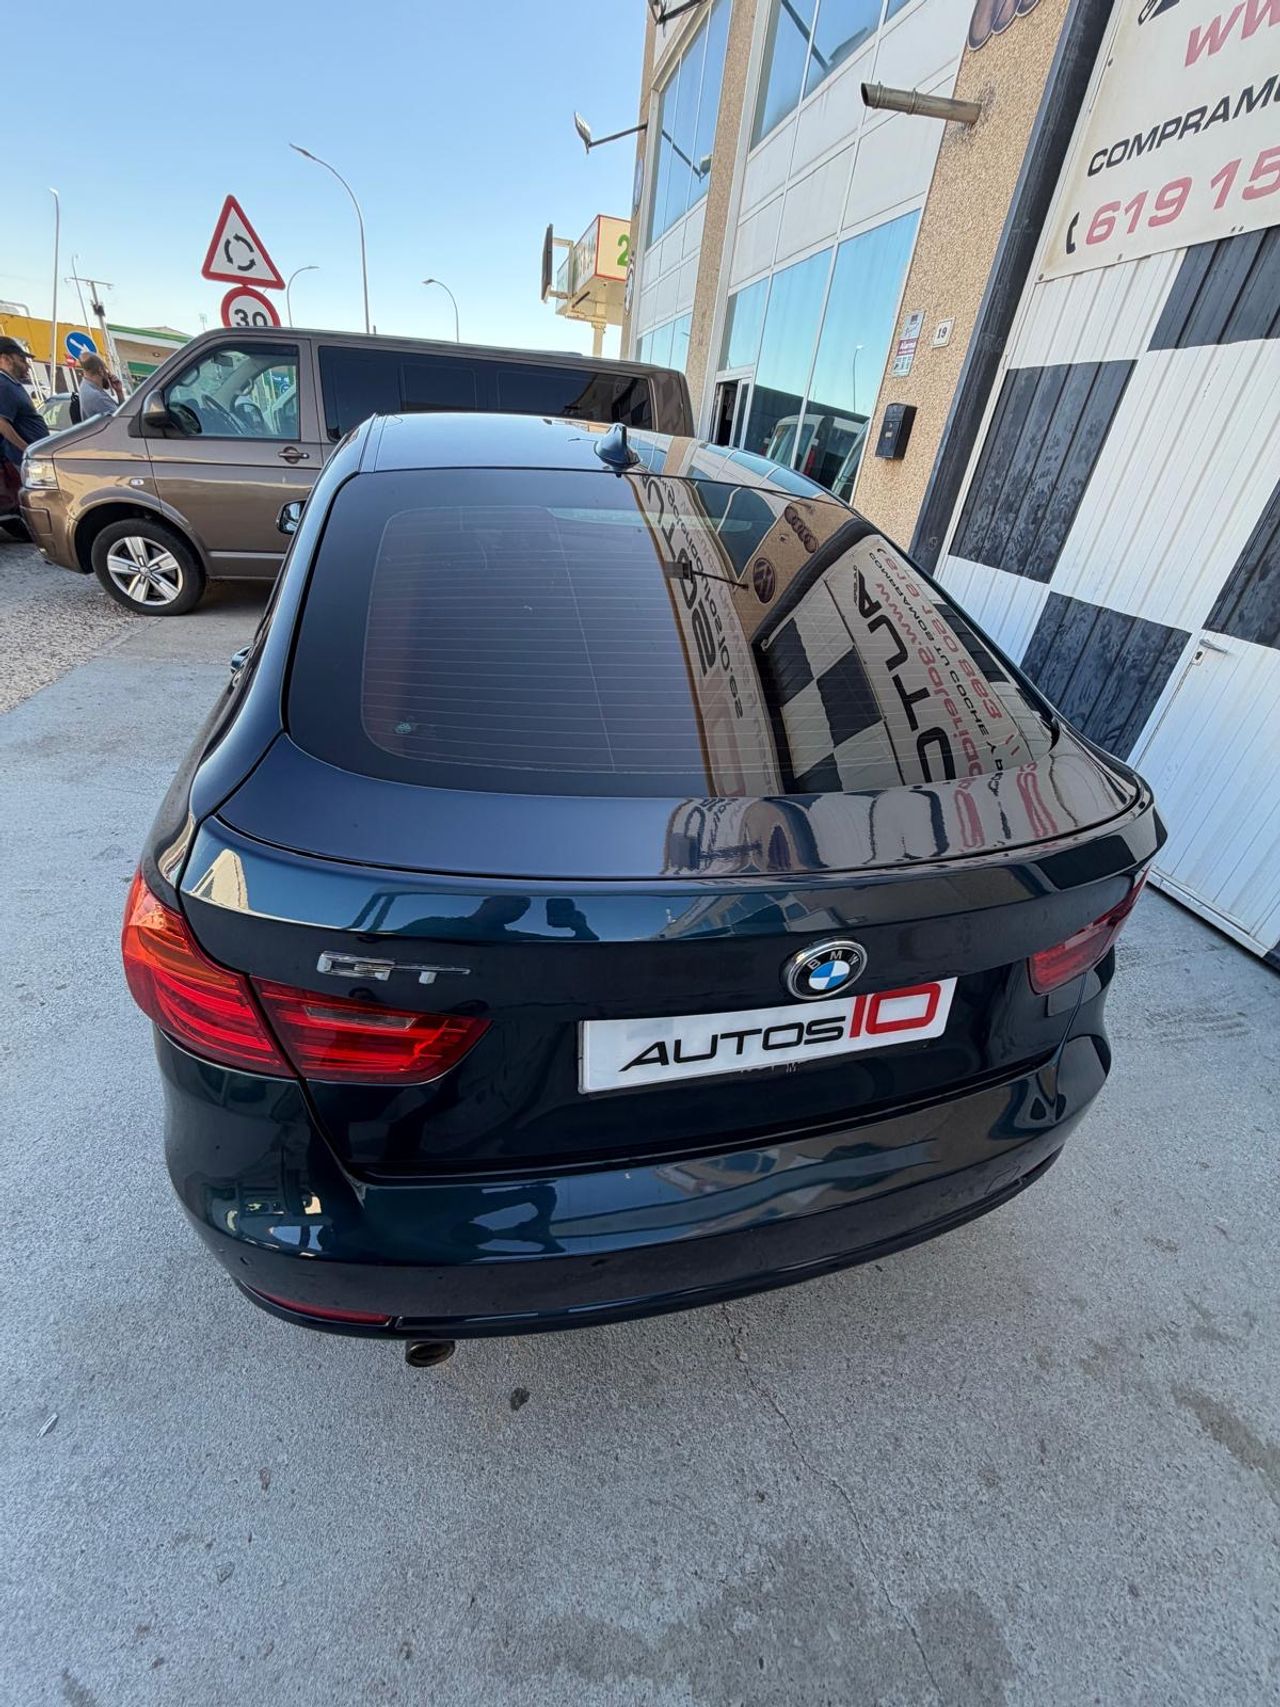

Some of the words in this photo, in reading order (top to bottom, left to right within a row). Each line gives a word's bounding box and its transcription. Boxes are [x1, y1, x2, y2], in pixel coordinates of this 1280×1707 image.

[1086, 177, 1192, 245] 619
[234, 309, 268, 327] 30
[937, 326, 948, 339] 19
[317, 950, 471, 985] GT
[807, 950, 860, 970] BMW
[619, 983, 942, 1072] AUTOS10
